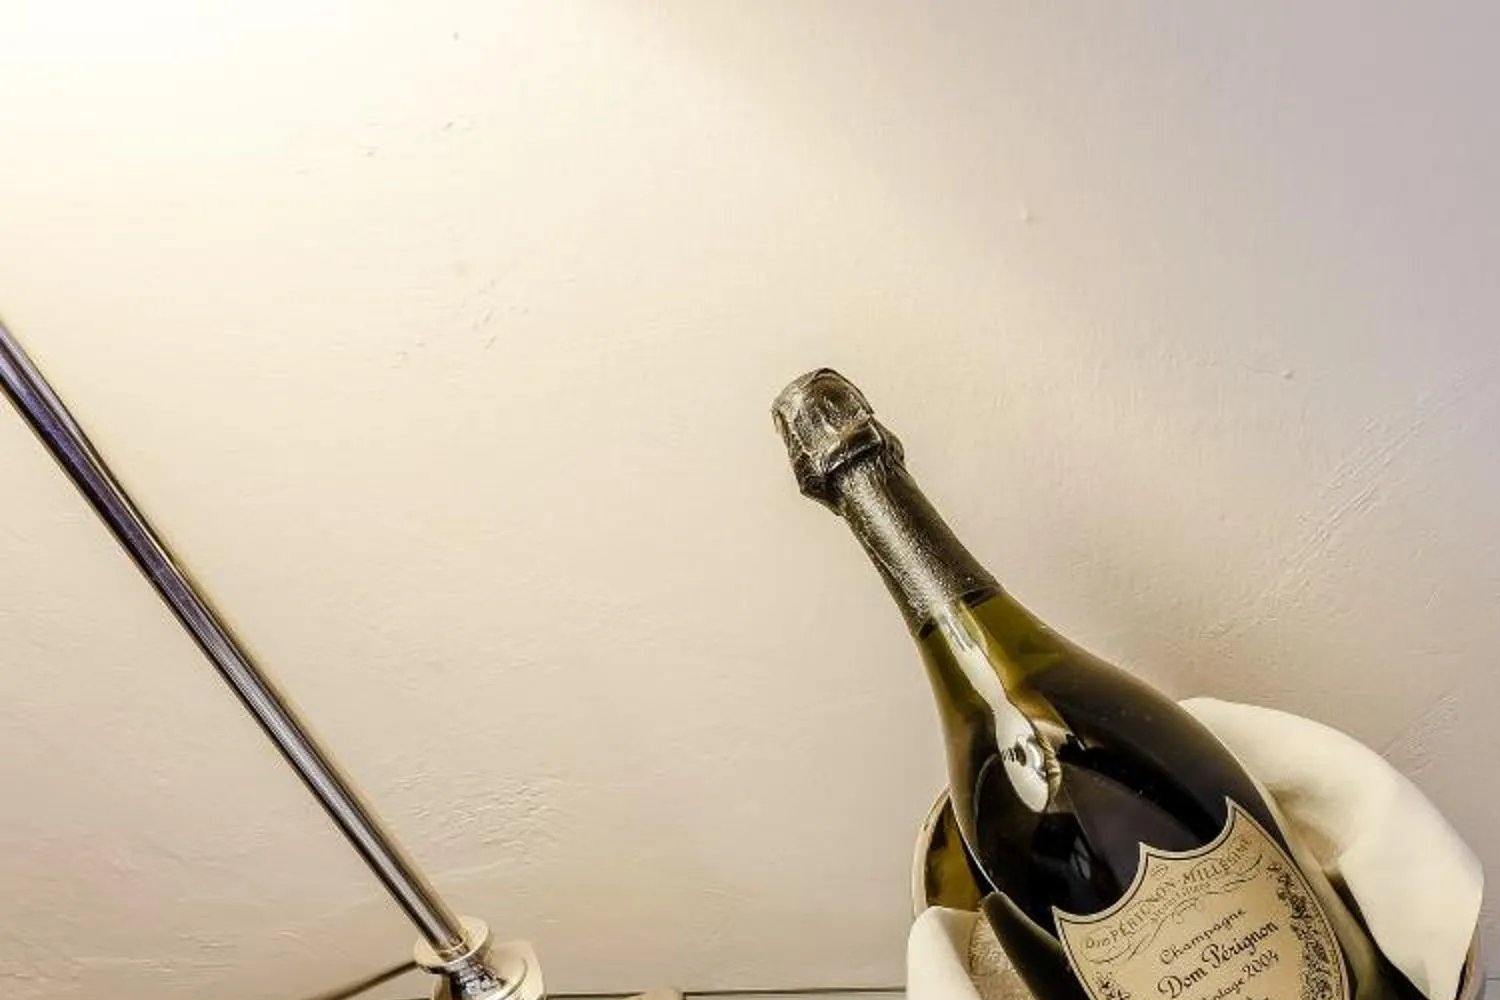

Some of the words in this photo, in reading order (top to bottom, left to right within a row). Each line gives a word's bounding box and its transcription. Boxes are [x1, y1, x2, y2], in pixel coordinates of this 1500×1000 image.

[1157, 966, 1208, 999] Dom
[1200, 921, 1279, 969] Pérignon
[1160, 908, 1246, 965] Champagne
